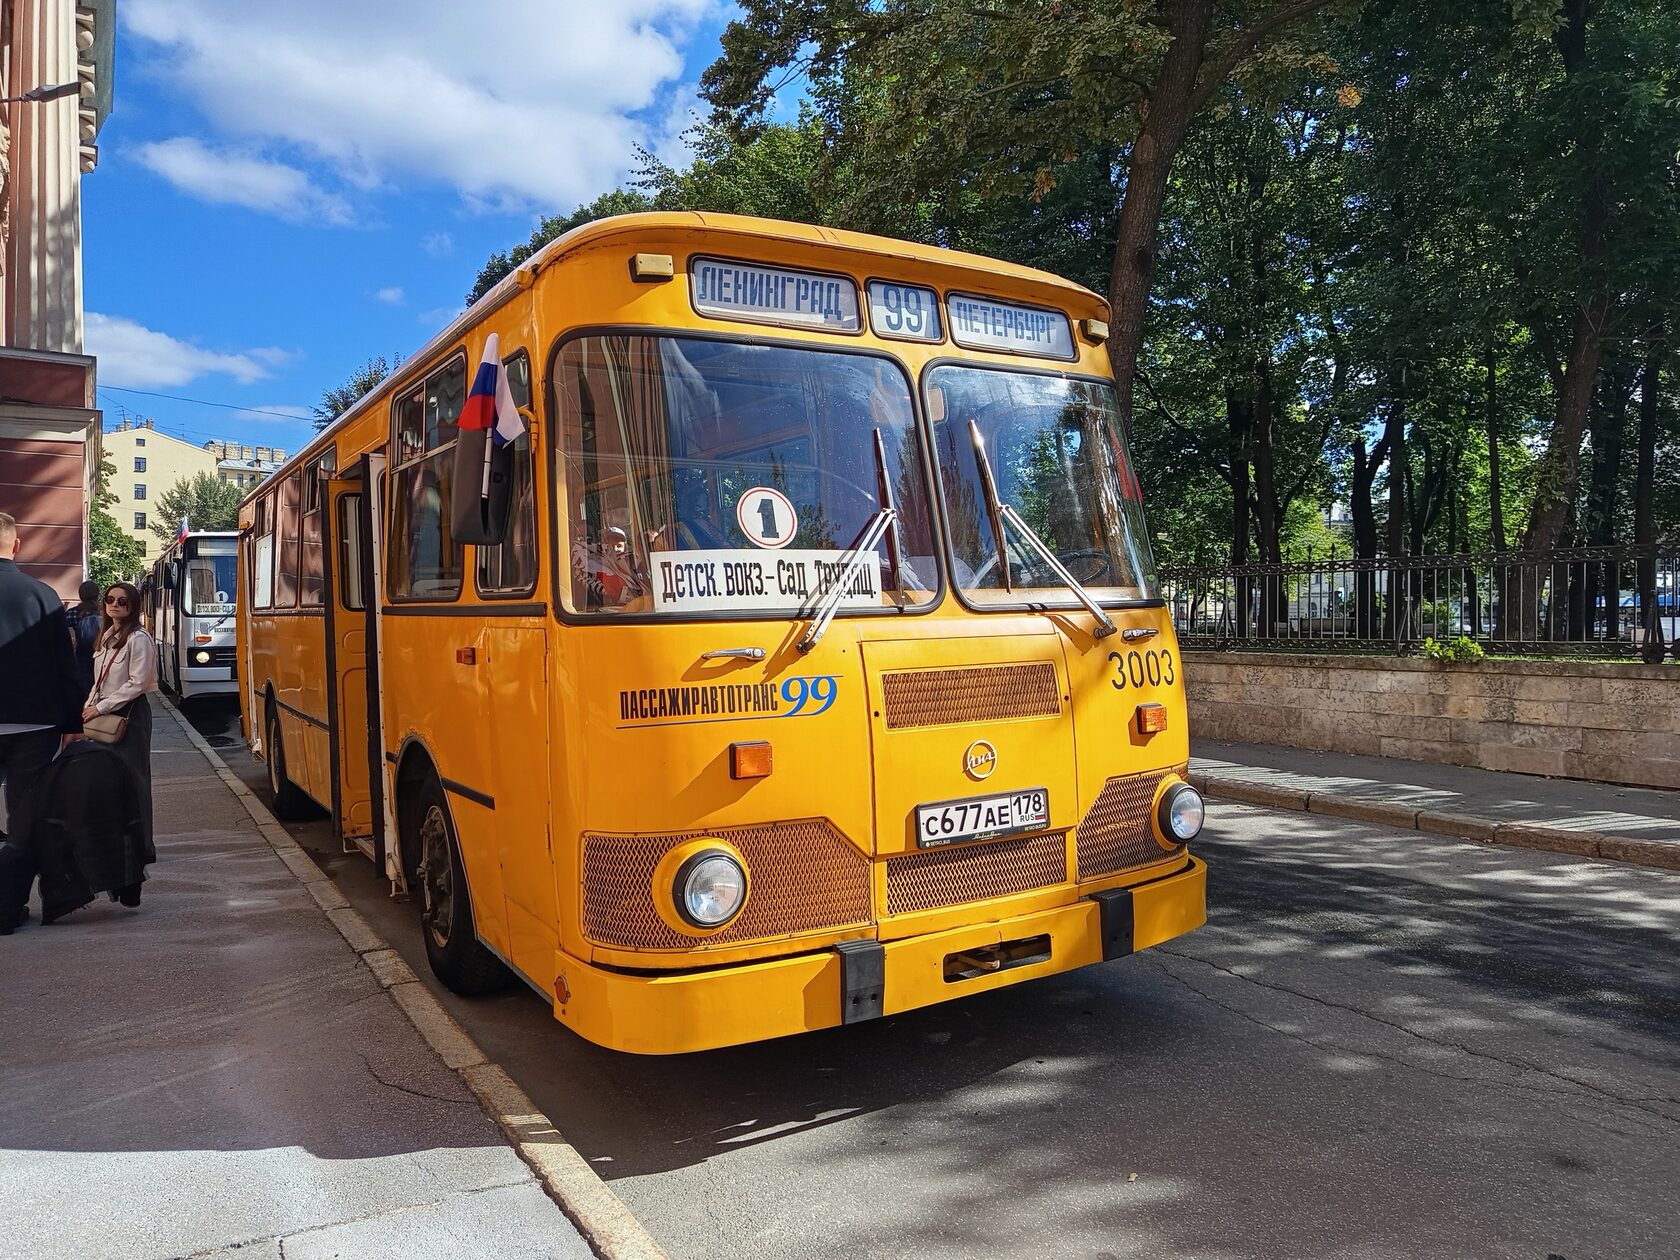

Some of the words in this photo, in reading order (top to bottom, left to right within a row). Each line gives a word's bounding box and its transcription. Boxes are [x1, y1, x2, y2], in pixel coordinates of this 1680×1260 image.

[699, 266, 843, 321] ЛЕНИНГРАД
[883, 284, 922, 334] 99
[956, 302, 1057, 344] ПЕТЕРБУРГ
[756, 498, 780, 539] 1
[1108, 649, 1174, 690] 3003
[619, 683, 779, 720] ПАССАЖИРАВТОТРАНС
[780, 675, 838, 717] 99
[1013, 793, 1042, 816] 178
[1020, 813, 1035, 823] RUS
